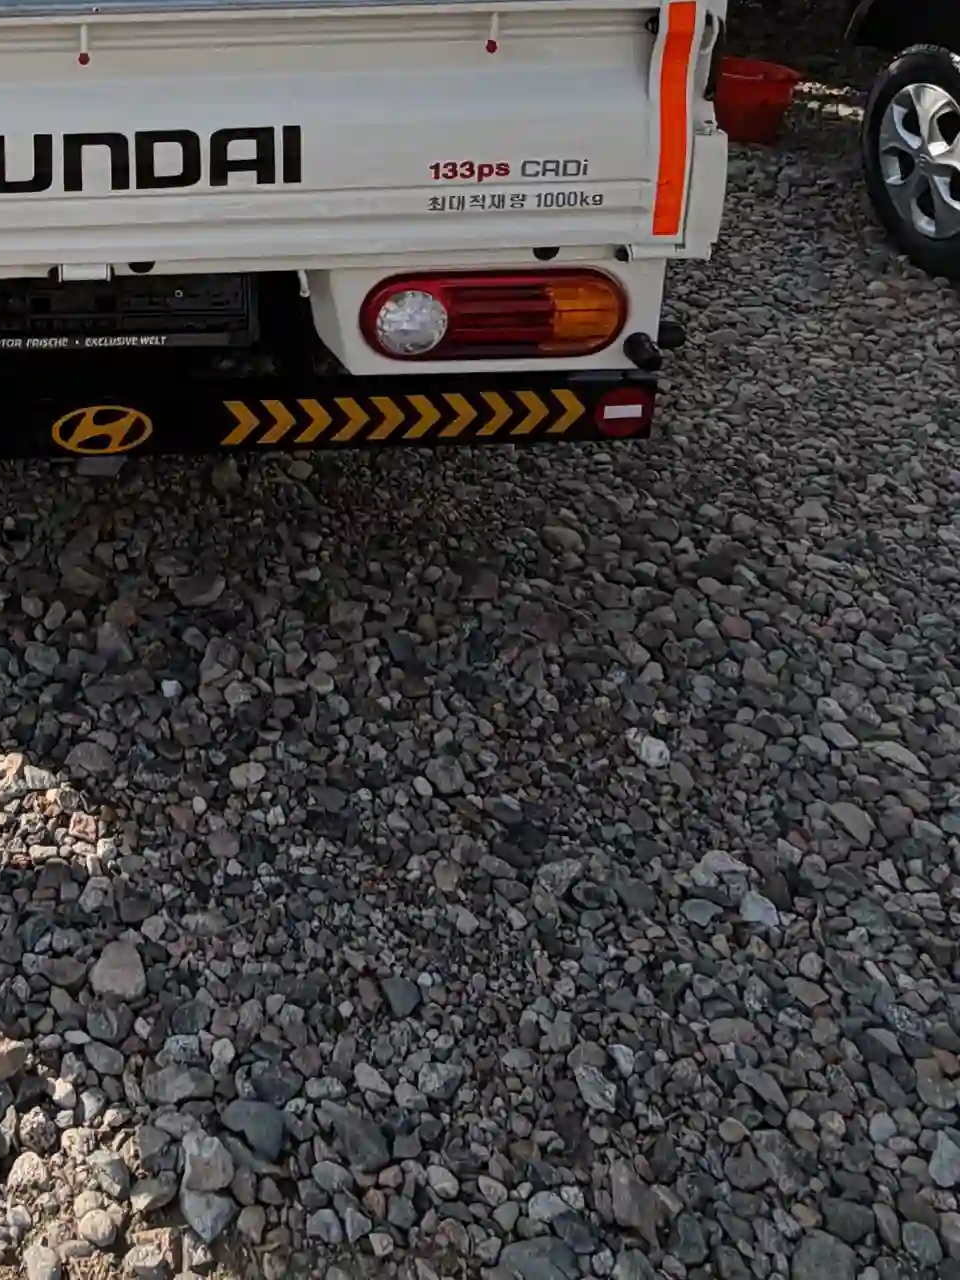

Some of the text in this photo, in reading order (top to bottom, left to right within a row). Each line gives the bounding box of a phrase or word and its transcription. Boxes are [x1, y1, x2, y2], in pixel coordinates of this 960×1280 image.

[429, 160, 510, 182] 133ps
[428, 191, 604, 211] 최대적재량 1000kg
[141, 336, 167, 345] WELT
